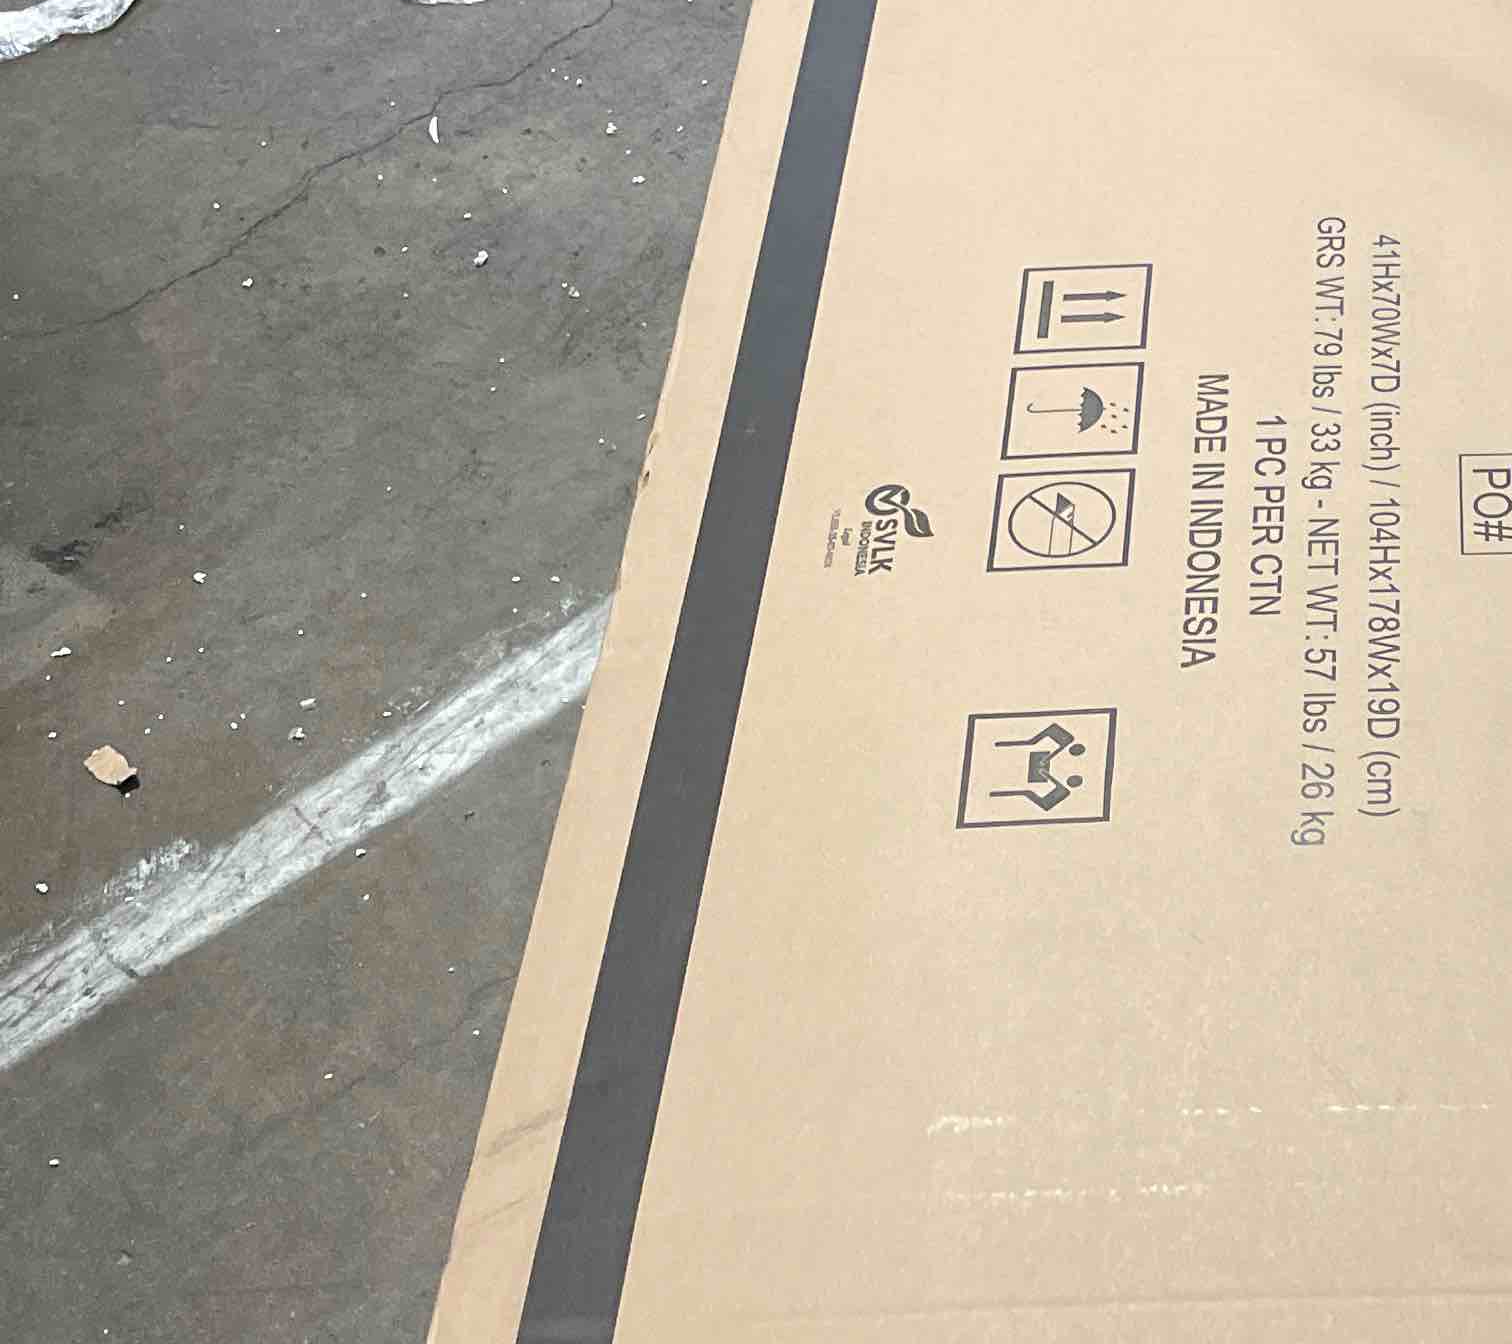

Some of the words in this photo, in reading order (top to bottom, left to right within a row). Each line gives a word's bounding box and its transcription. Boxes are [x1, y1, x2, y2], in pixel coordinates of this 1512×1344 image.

[1316, 217, 1346, 268] GRS
[1371, 235, 1400, 392] 41Hx70Wx7D
[1312, 365, 1342, 398] lbs
[1194, 374, 1229, 453] MADE
[1256, 416, 1287, 425] 1
[1311, 423, 1341, 452] 33
[1362, 403, 1400, 471] (inch)
[1192, 463, 1225, 489] IN
[1255, 438, 1287, 476] PC
[1301, 462, 1340, 489] kg
[1252, 486, 1285, 546] PER
[854, 521, 872, 576] INDONESIA
[868, 519, 898, 575] SVLK
[1307, 519, 1339, 576] NET
[1181, 499, 1223, 668] INDONESIA
[1249, 554, 1282, 615] CTN
[1368, 498, 1400, 738] 104Hx178Wx19D
[1303, 693, 1336, 733] lbs
[1301, 763, 1334, 799] 26
[1358, 751, 1400, 816] (cm)
[1291, 812, 1334, 845] kg
